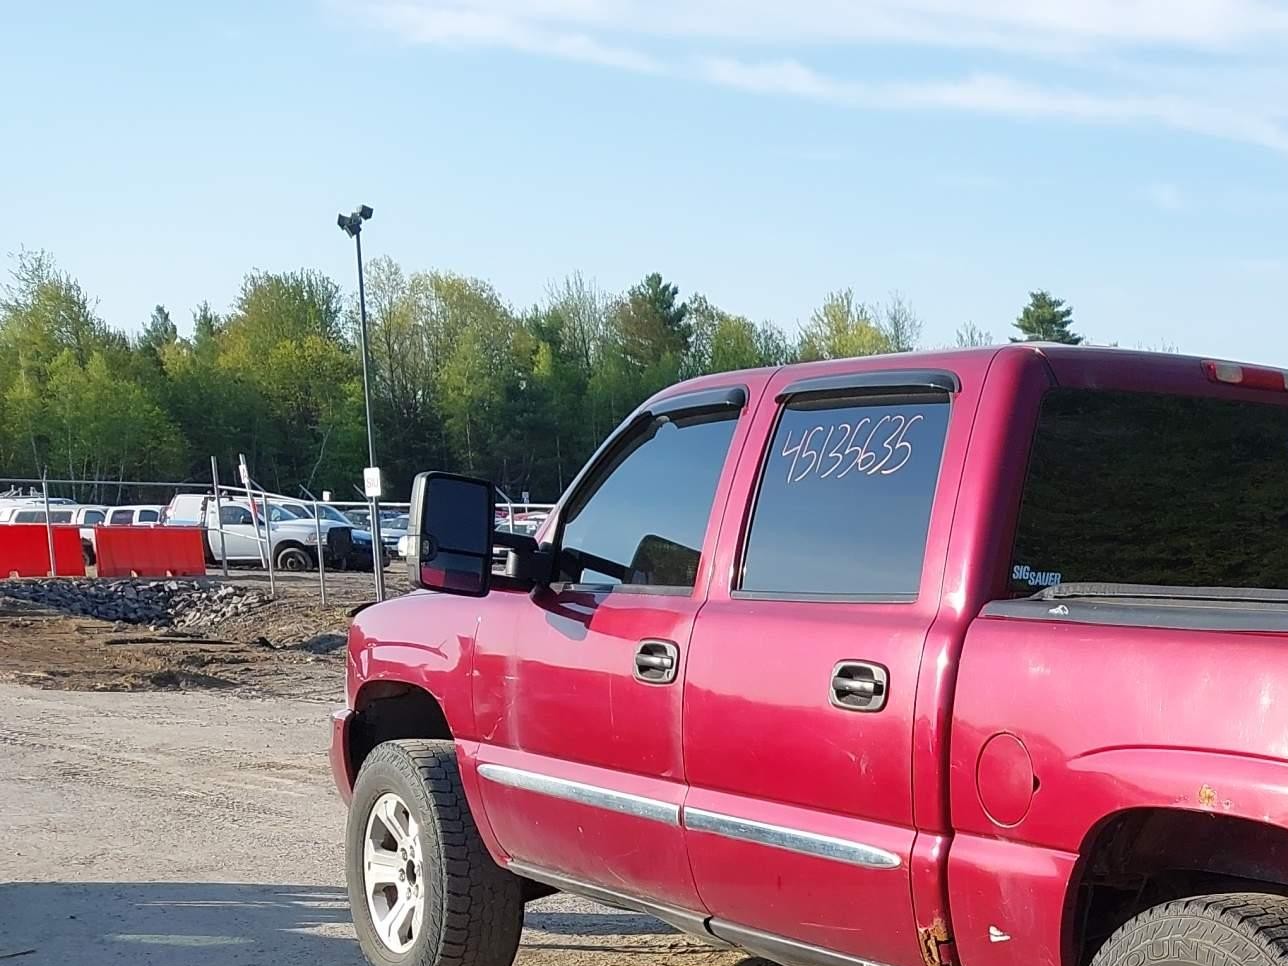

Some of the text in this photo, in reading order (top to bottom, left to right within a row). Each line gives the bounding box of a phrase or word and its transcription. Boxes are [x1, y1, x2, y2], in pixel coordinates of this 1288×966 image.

[782, 415, 924, 484] 45135635
[1012, 565, 1062, 586] SIG SAUER
